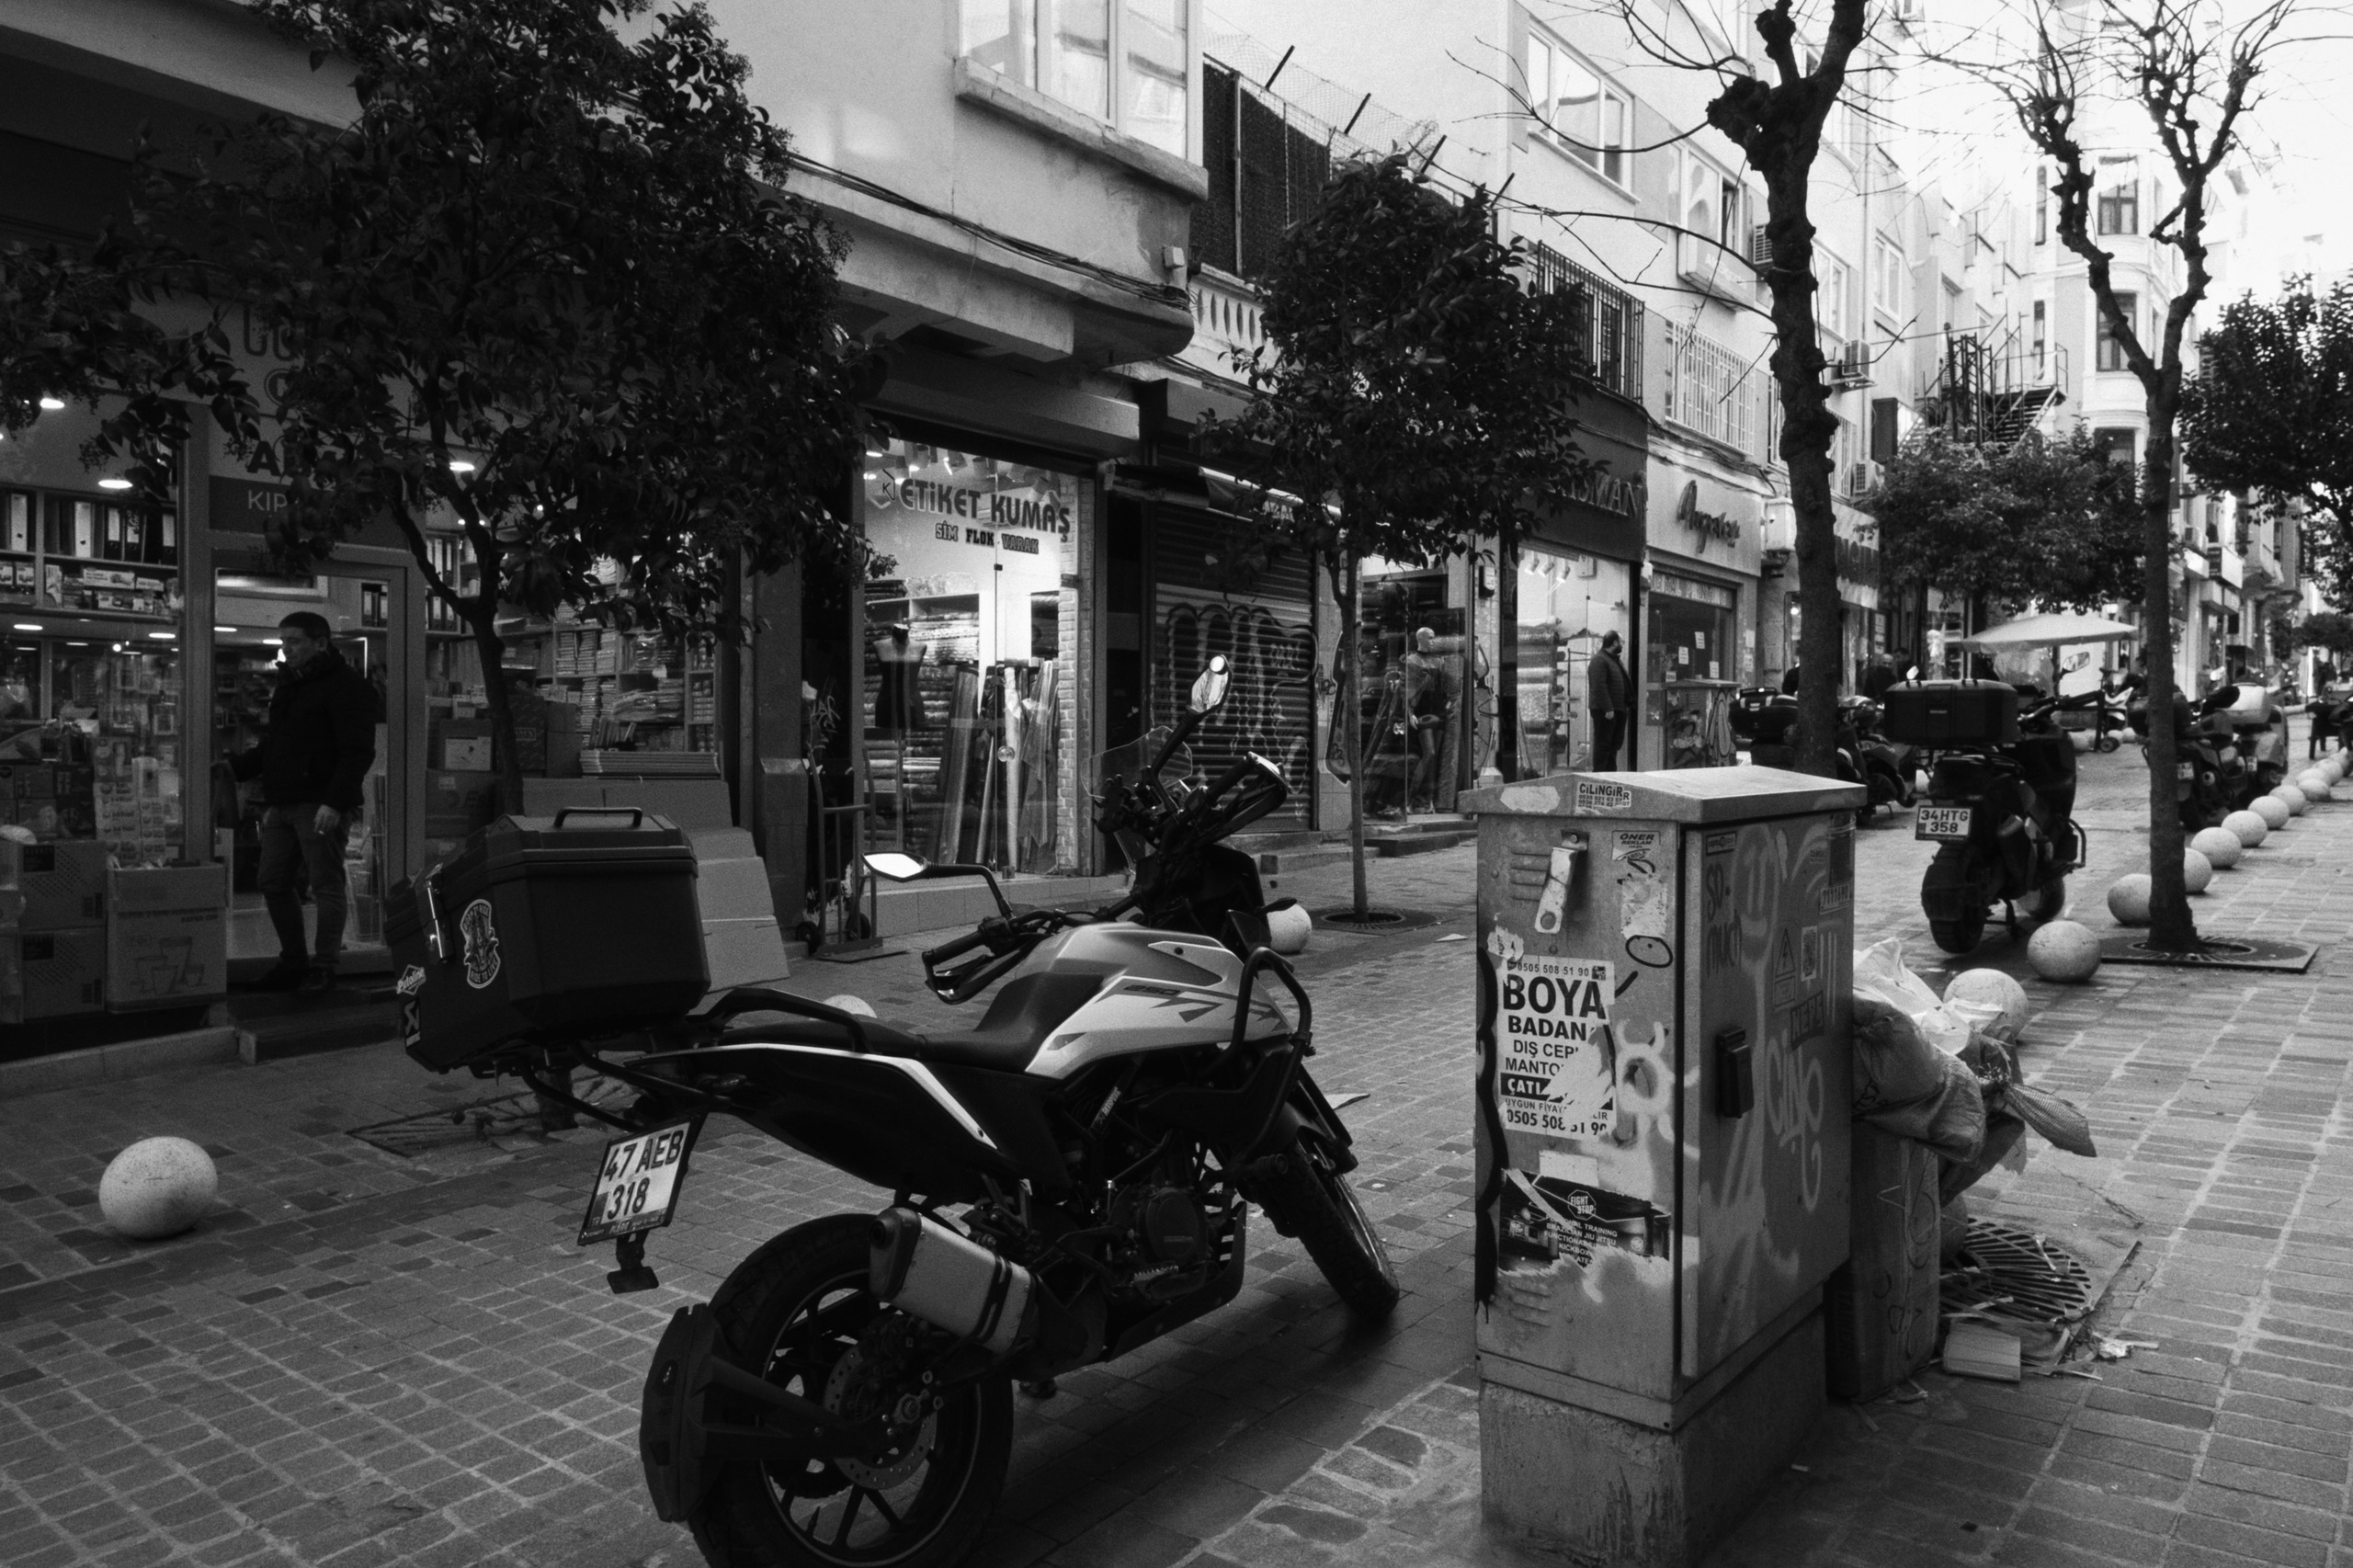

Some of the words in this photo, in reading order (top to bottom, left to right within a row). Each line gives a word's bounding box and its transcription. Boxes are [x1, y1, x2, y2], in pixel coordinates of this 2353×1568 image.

[991, 494, 1071, 542] KUMAŞ
[965, 528, 995, 547] FLOK
[1001, 533, 1040, 554] VARAK
[1930, 822, 1959, 834] 358
[1518, 962, 1540, 972] 0505
[1543, 964, 1559, 974] 508
[1563, 966, 1574, 975] 51
[1578, 967, 1589, 976] 90
[1503, 973, 1606, 1019] BOYA
[1508, 1015, 1595, 1041] BADAN
[1514, 1040, 1538, 1059] DIŞ
[1543, 1043, 1579, 1059] CEP
[1506, 1057, 1563, 1076] MANTO
[1506, 1097, 1536, 1109] UYGUN
[1506, 1109, 1537, 1126] 0505
[608, 1176, 650, 1220] 318
[1570, 1196, 1588, 1205] FIGHT
[1577, 1204, 1595, 1214] STOP
[1585, 1223, 1618, 1238] TRAINING
